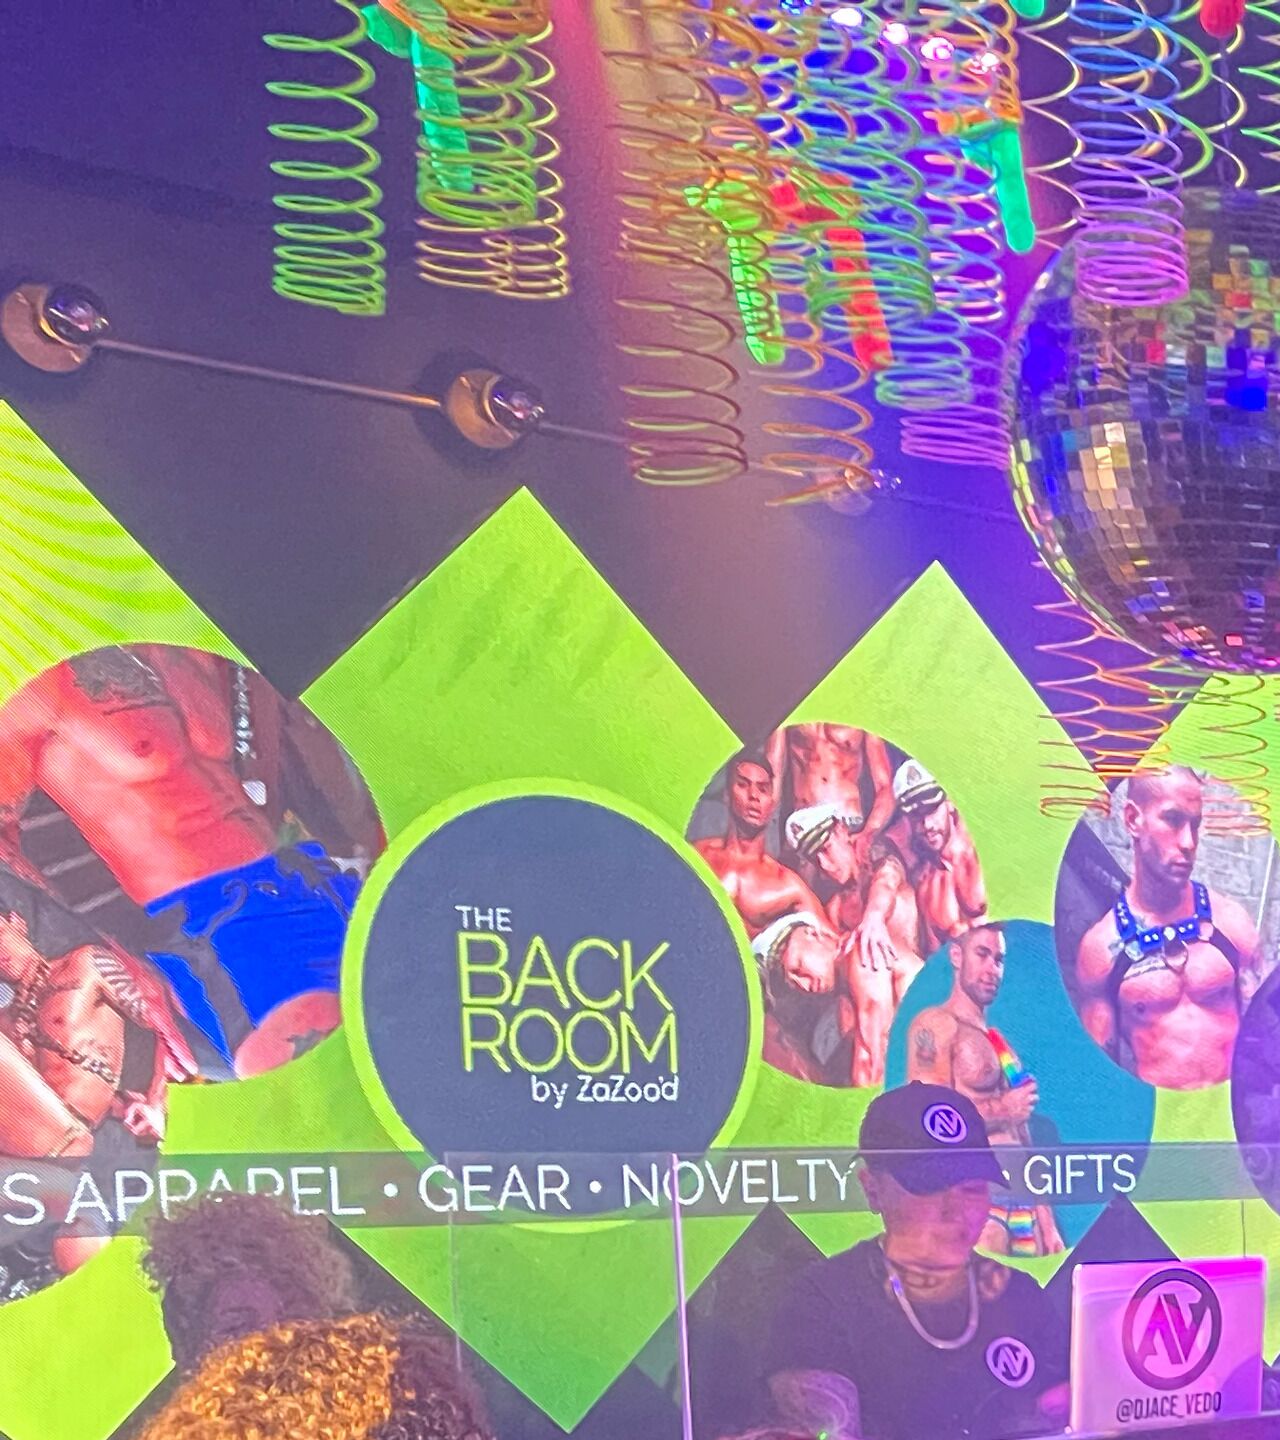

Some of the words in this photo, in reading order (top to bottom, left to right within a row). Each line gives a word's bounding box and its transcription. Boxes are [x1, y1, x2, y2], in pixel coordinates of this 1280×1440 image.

[454, 904, 513, 932] THE
[456, 931, 674, 1012] BACK
[461, 1005, 680, 1075] ROOM
[531, 1074, 569, 1109] by
[417, 1162, 573, 1213] GEAR
[621, 1155, 858, 1209] NOVELTY
[1023, 1152, 1137, 1195] GIFTS
